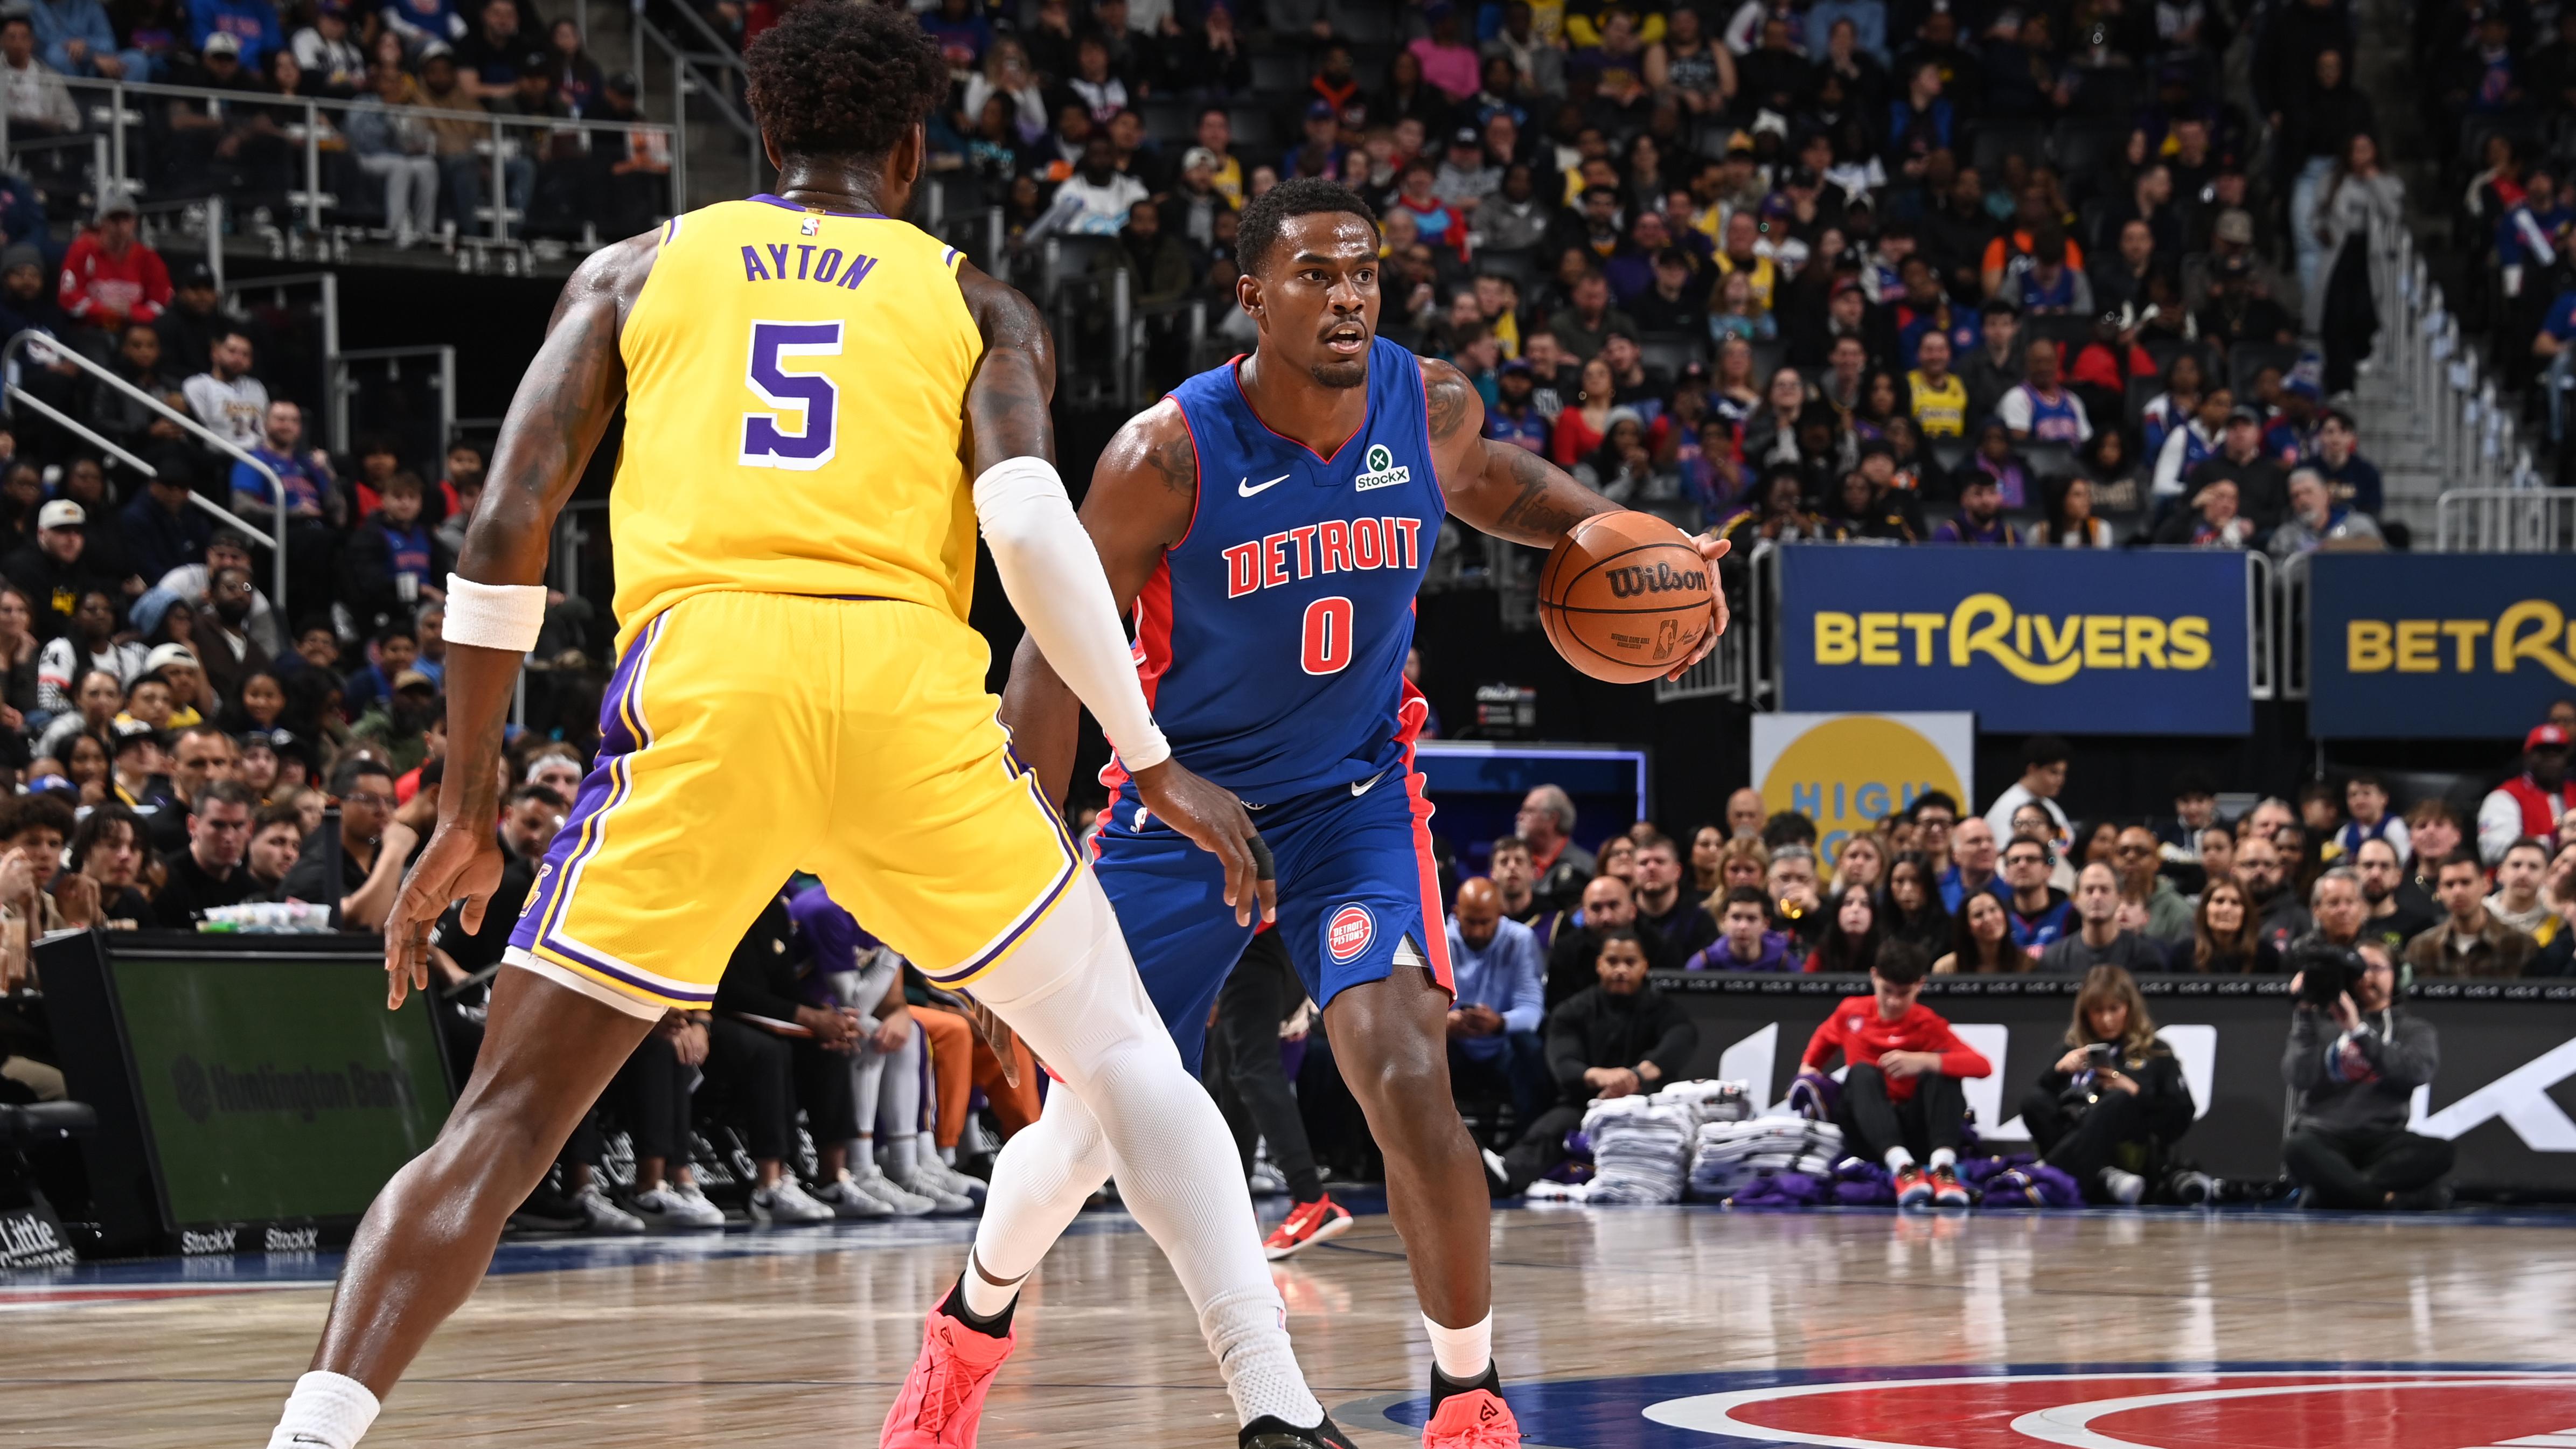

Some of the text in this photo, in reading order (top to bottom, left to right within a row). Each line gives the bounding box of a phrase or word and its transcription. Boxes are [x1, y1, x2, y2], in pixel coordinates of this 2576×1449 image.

[741, 243, 879, 290] AYTON
[739, 319, 845, 471] 5
[1358, 469, 1407, 488] StockX
[1222, 517, 1422, 599] DETROIT
[1605, 561, 1708, 598] Wilson
[1301, 596, 1353, 675] 0
[1814, 593, 2212, 685] BETRIVERS
[1333, 919, 1363, 937] DETROIT
[1333, 929, 1364, 947] PISTONS
[182, 1227, 236, 1255] StockX
[265, 1227, 318, 1251] StockX
